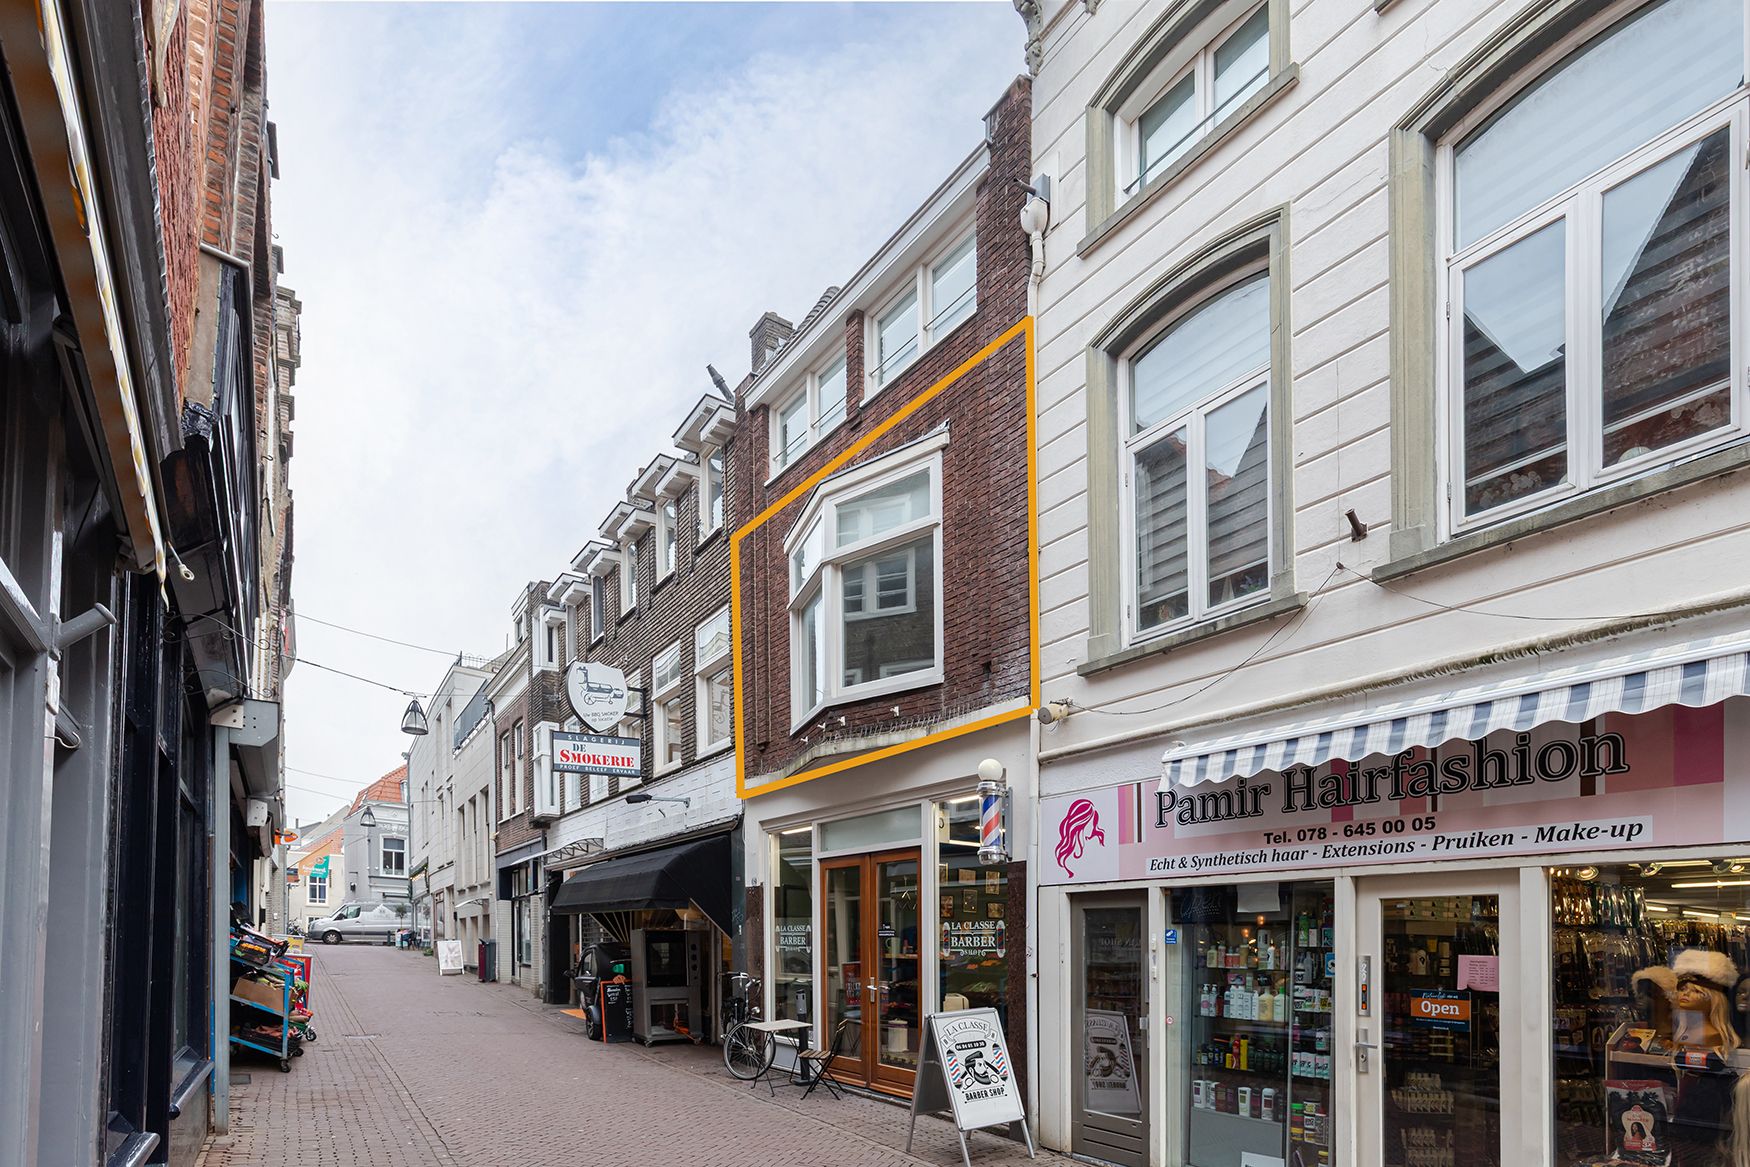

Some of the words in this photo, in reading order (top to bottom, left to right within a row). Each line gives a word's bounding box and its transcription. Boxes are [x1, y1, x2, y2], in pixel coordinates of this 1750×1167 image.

[568, 735, 625, 745] SLAGERIJ
[572, 743, 586, 752] DE
[560, 749, 634, 767] SMOKERIE
[1154, 778, 1271, 828] Pamir
[1281, 732, 1630, 813] Hairfashion
[1263, 831, 1292, 844] Tel.
[1297, 827, 1327, 841] 078
[1343, 822, 1376, 837] 645
[1382, 820, 1405, 834] 00
[1412, 816, 1436, 831] 05
[1150, 858, 1175, 871] Echt
[1178, 856, 1187, 869] &
[1191, 849, 1267, 871] Synthetisch
[1271, 849, 1309, 862] haar
[1322, 839, 1416, 859] Extensions
[1431, 831, 1514, 851] Pruiken
[1534, 822, 1644, 843] Make-up
[787, 924, 806, 932] CLASSE
[951, 922, 961, 930] LA
[963, 920, 995, 929] CLASSE
[780, 936, 806, 945] BARBER
[951, 936, 996, 947] BARBER
[1421, 1000, 1459, 1017] Open
[946, 1026, 958, 1036] LA
[958, 1021, 989, 1032] CLASSE
[965, 1089, 988, 1101] BARBER
[990, 1086, 1005, 1097] SHOP
